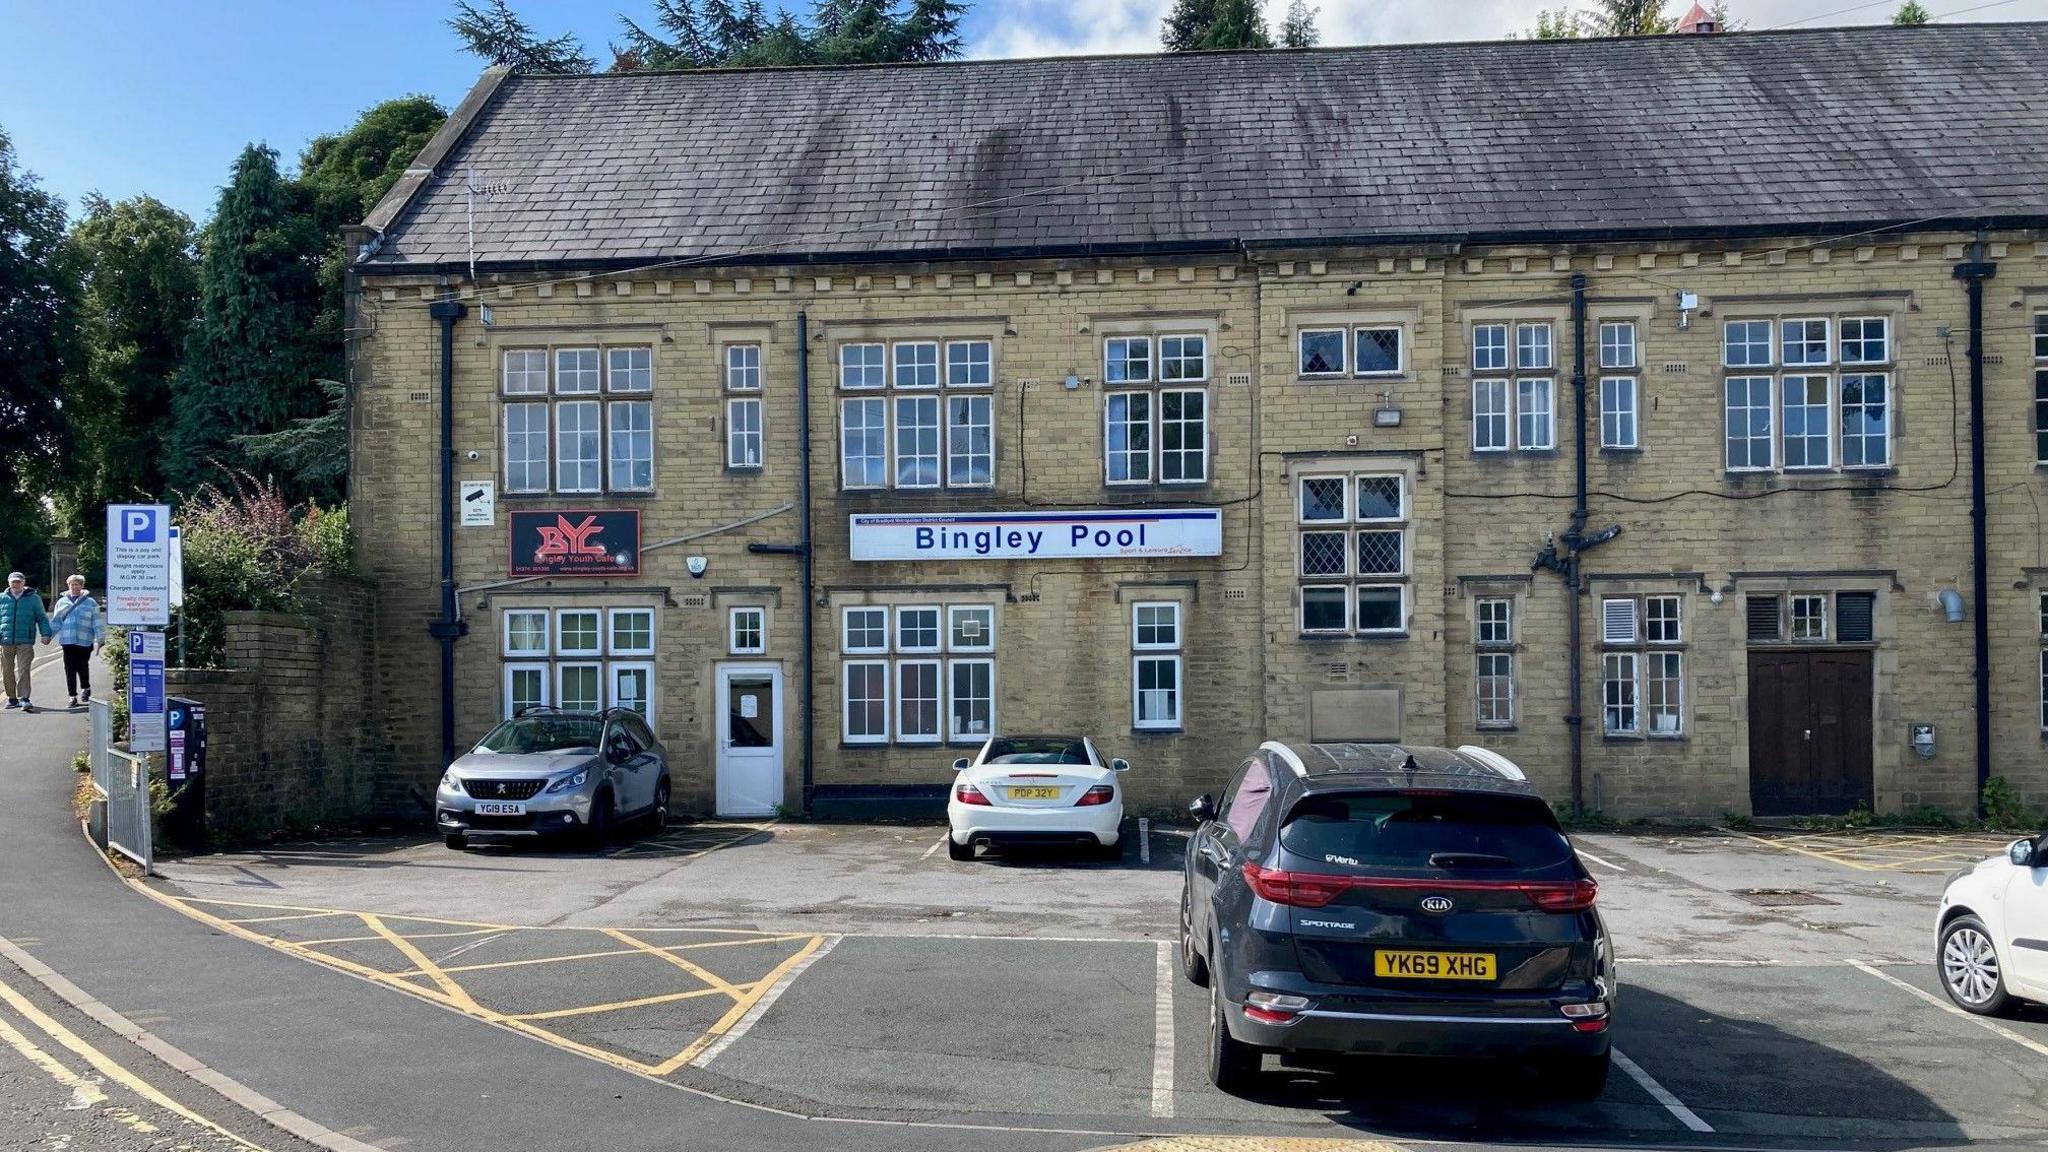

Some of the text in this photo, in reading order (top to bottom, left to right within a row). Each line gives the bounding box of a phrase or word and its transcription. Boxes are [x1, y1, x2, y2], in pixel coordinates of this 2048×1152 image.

[128, 512, 150, 540] P
[535, 514, 606, 554] BYC
[916, 524, 1145, 554] Bingley Pool
[133, 635, 141, 651] P
[171, 710, 180, 726] P
[1035, 788, 1053, 797] 32Y
[480, 804, 520, 813] YG19 ESA
[1334, 855, 1358, 865] Vertu
[1427, 900, 1448, 909] KIA
[1300, 920, 1356, 929] SPORTAGE
[1384, 954, 1486, 975] YK69 XHG
